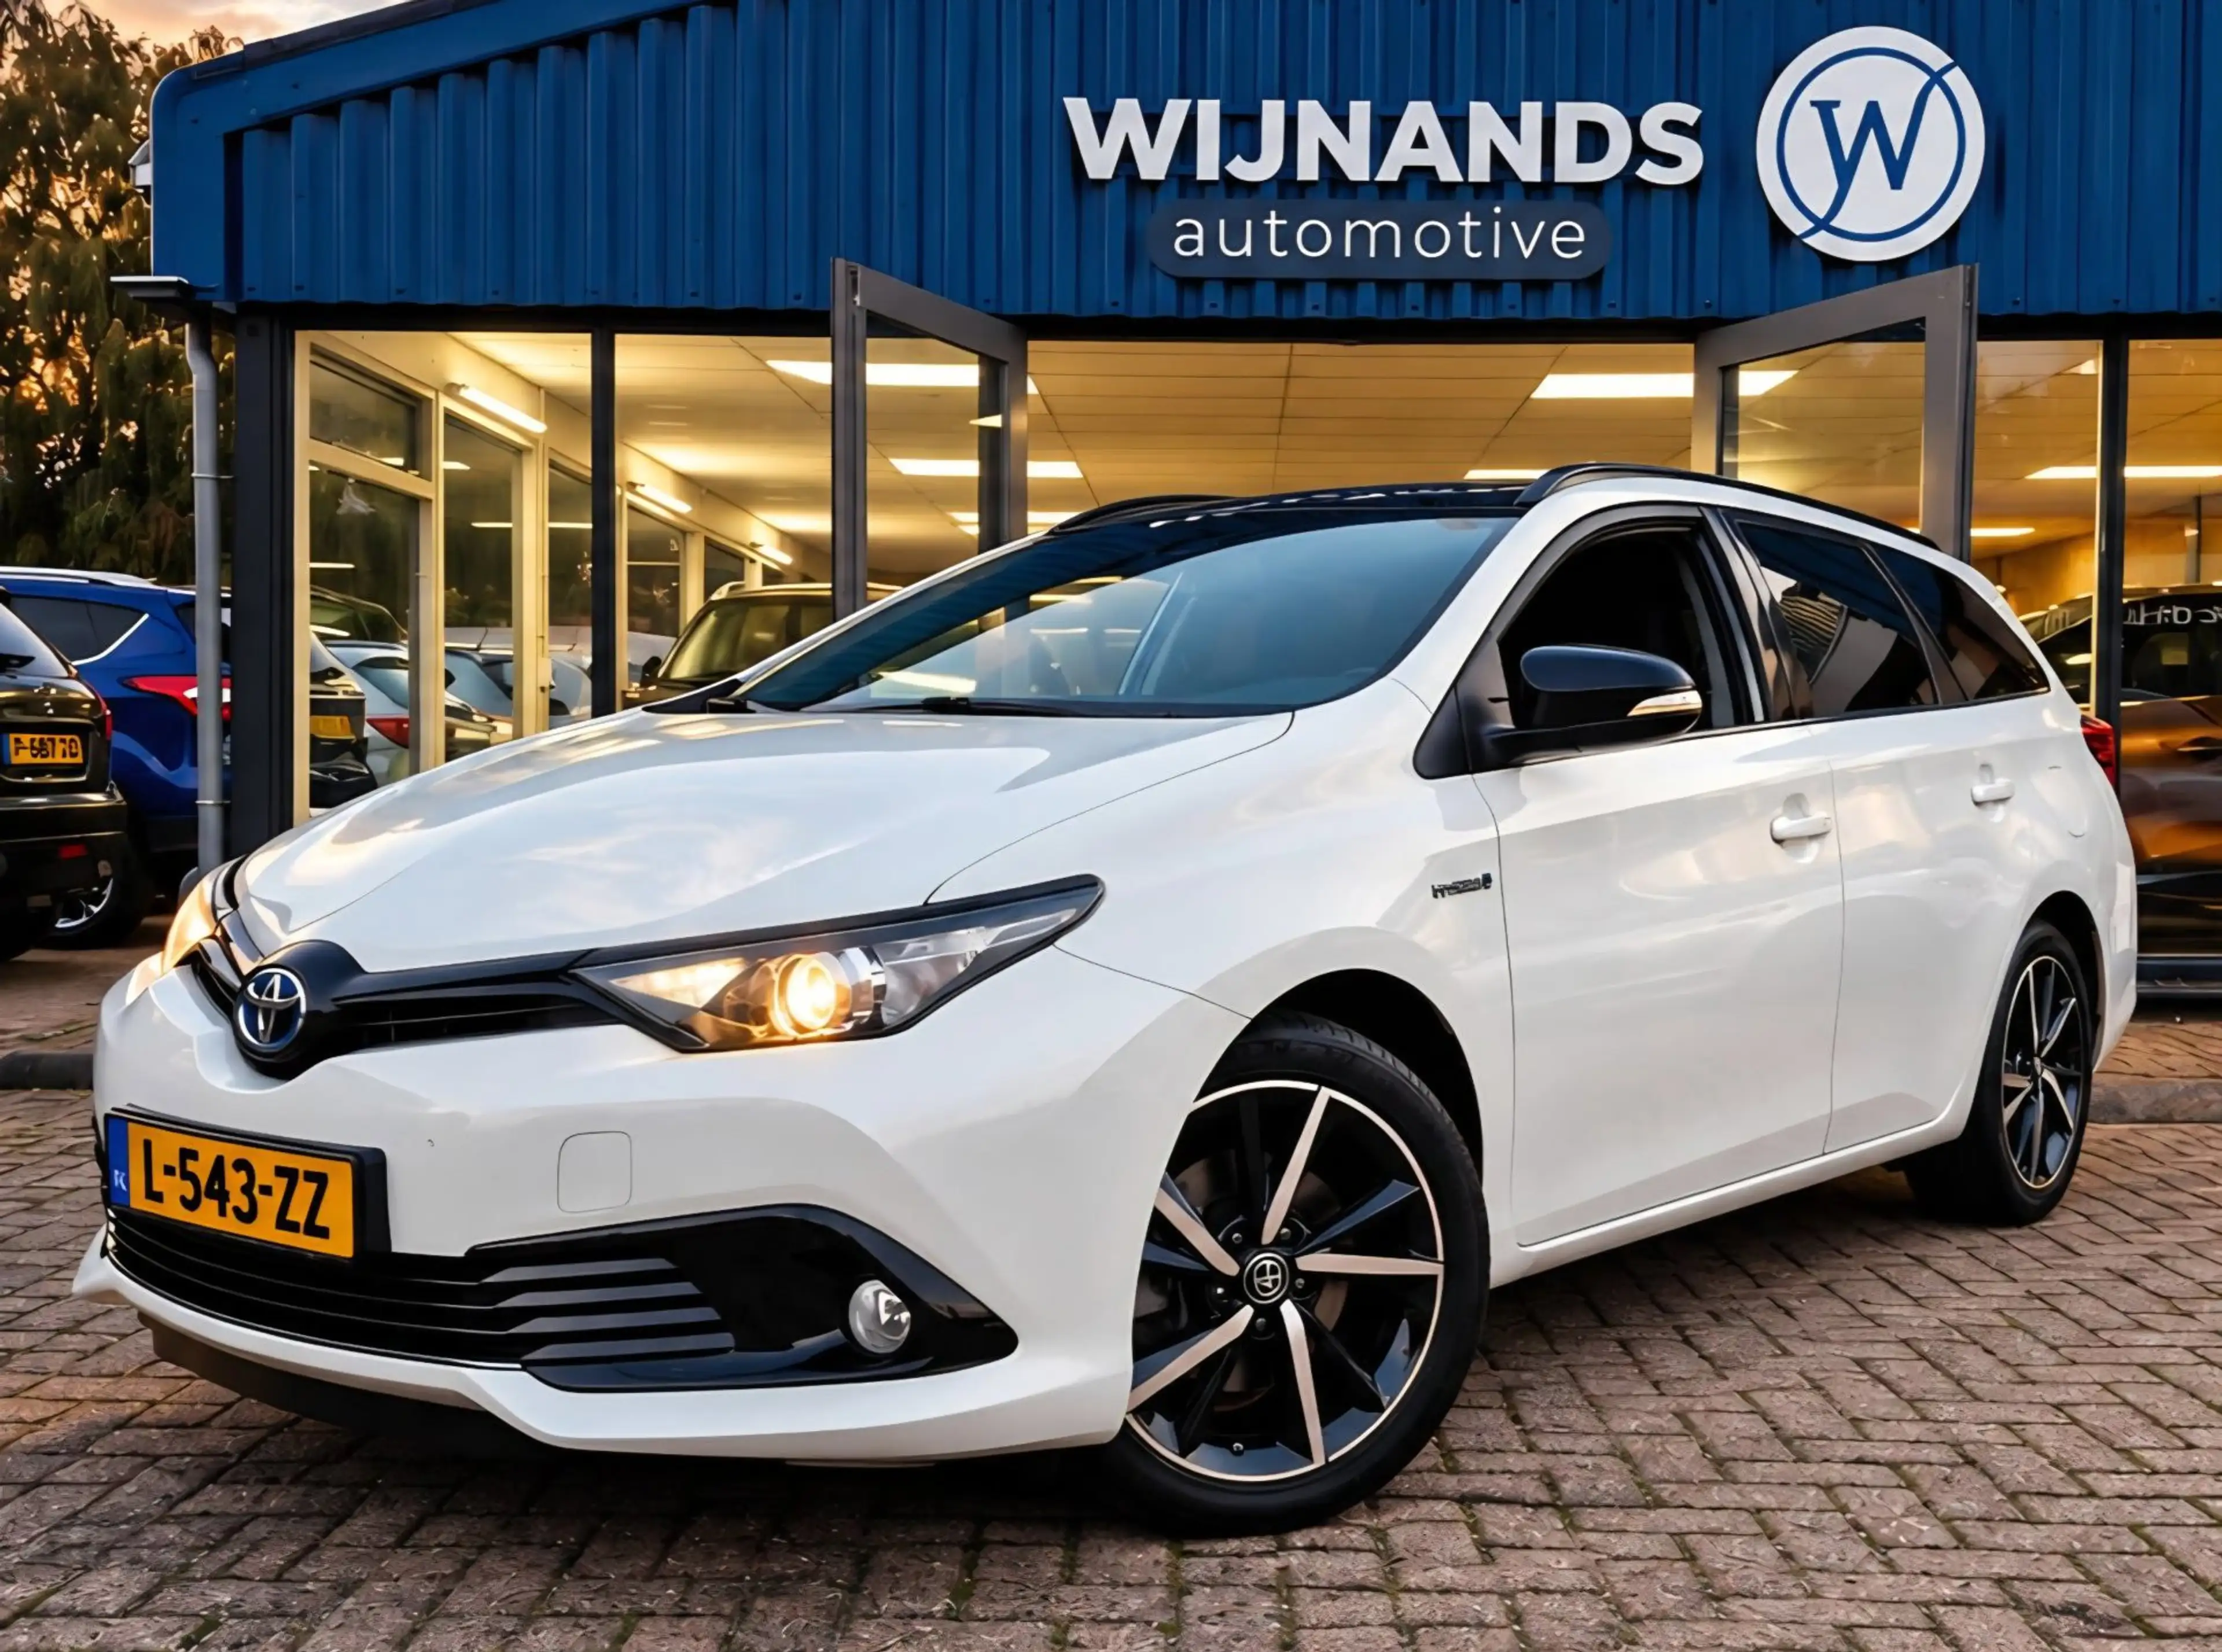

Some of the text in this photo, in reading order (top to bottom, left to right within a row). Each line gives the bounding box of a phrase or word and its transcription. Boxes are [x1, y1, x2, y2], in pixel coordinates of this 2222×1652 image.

[1064, 97, 1704, 185] WIJNANDS
[1174, 206, 1585, 259] automotive
[143, 1138, 330, 1239] L-543-ZZ
